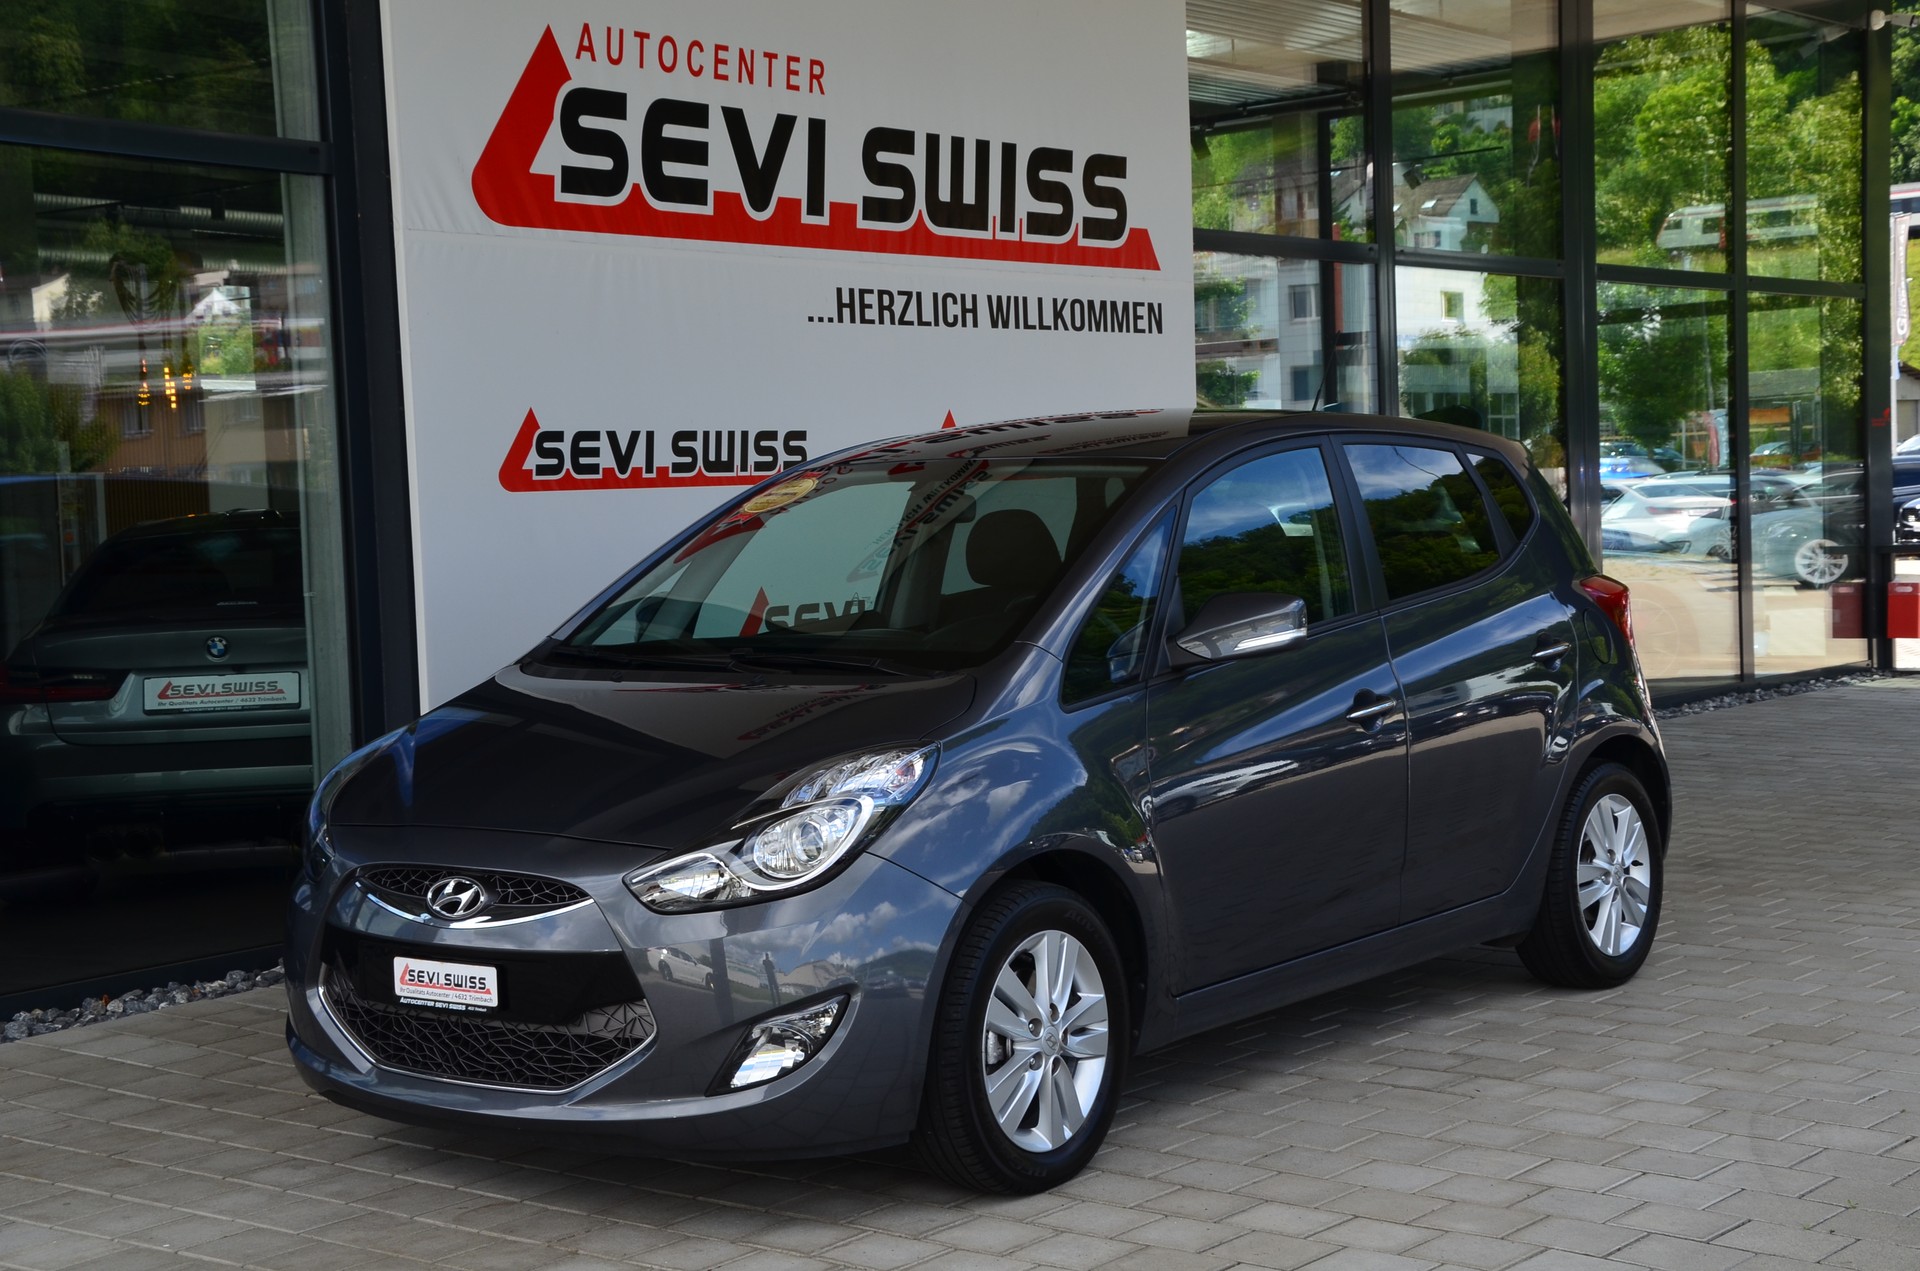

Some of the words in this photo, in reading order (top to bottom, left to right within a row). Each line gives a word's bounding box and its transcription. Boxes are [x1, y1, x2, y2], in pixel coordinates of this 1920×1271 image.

[575, 22, 826, 95] AUTOCENTER
[559, 86, 827, 218] SEVI
[861, 126, 1128, 242] SWISS
[806, 286, 979, 329] ...HERZLICH
[986, 294, 1164, 335] WILLKOMMEN
[534, 430, 655, 477] SEVI
[671, 430, 808, 474] SWISS
[170, 683, 216, 696] SEVI
[220, 680, 279, 694] SWISS
[199, 698, 234, 706] Autocenter
[407, 968, 440, 985] SEVI
[444, 973, 487, 990] SWISS
[425, 990, 451, 999] Autocenter
[468, 994, 493, 1004] Trimbach
